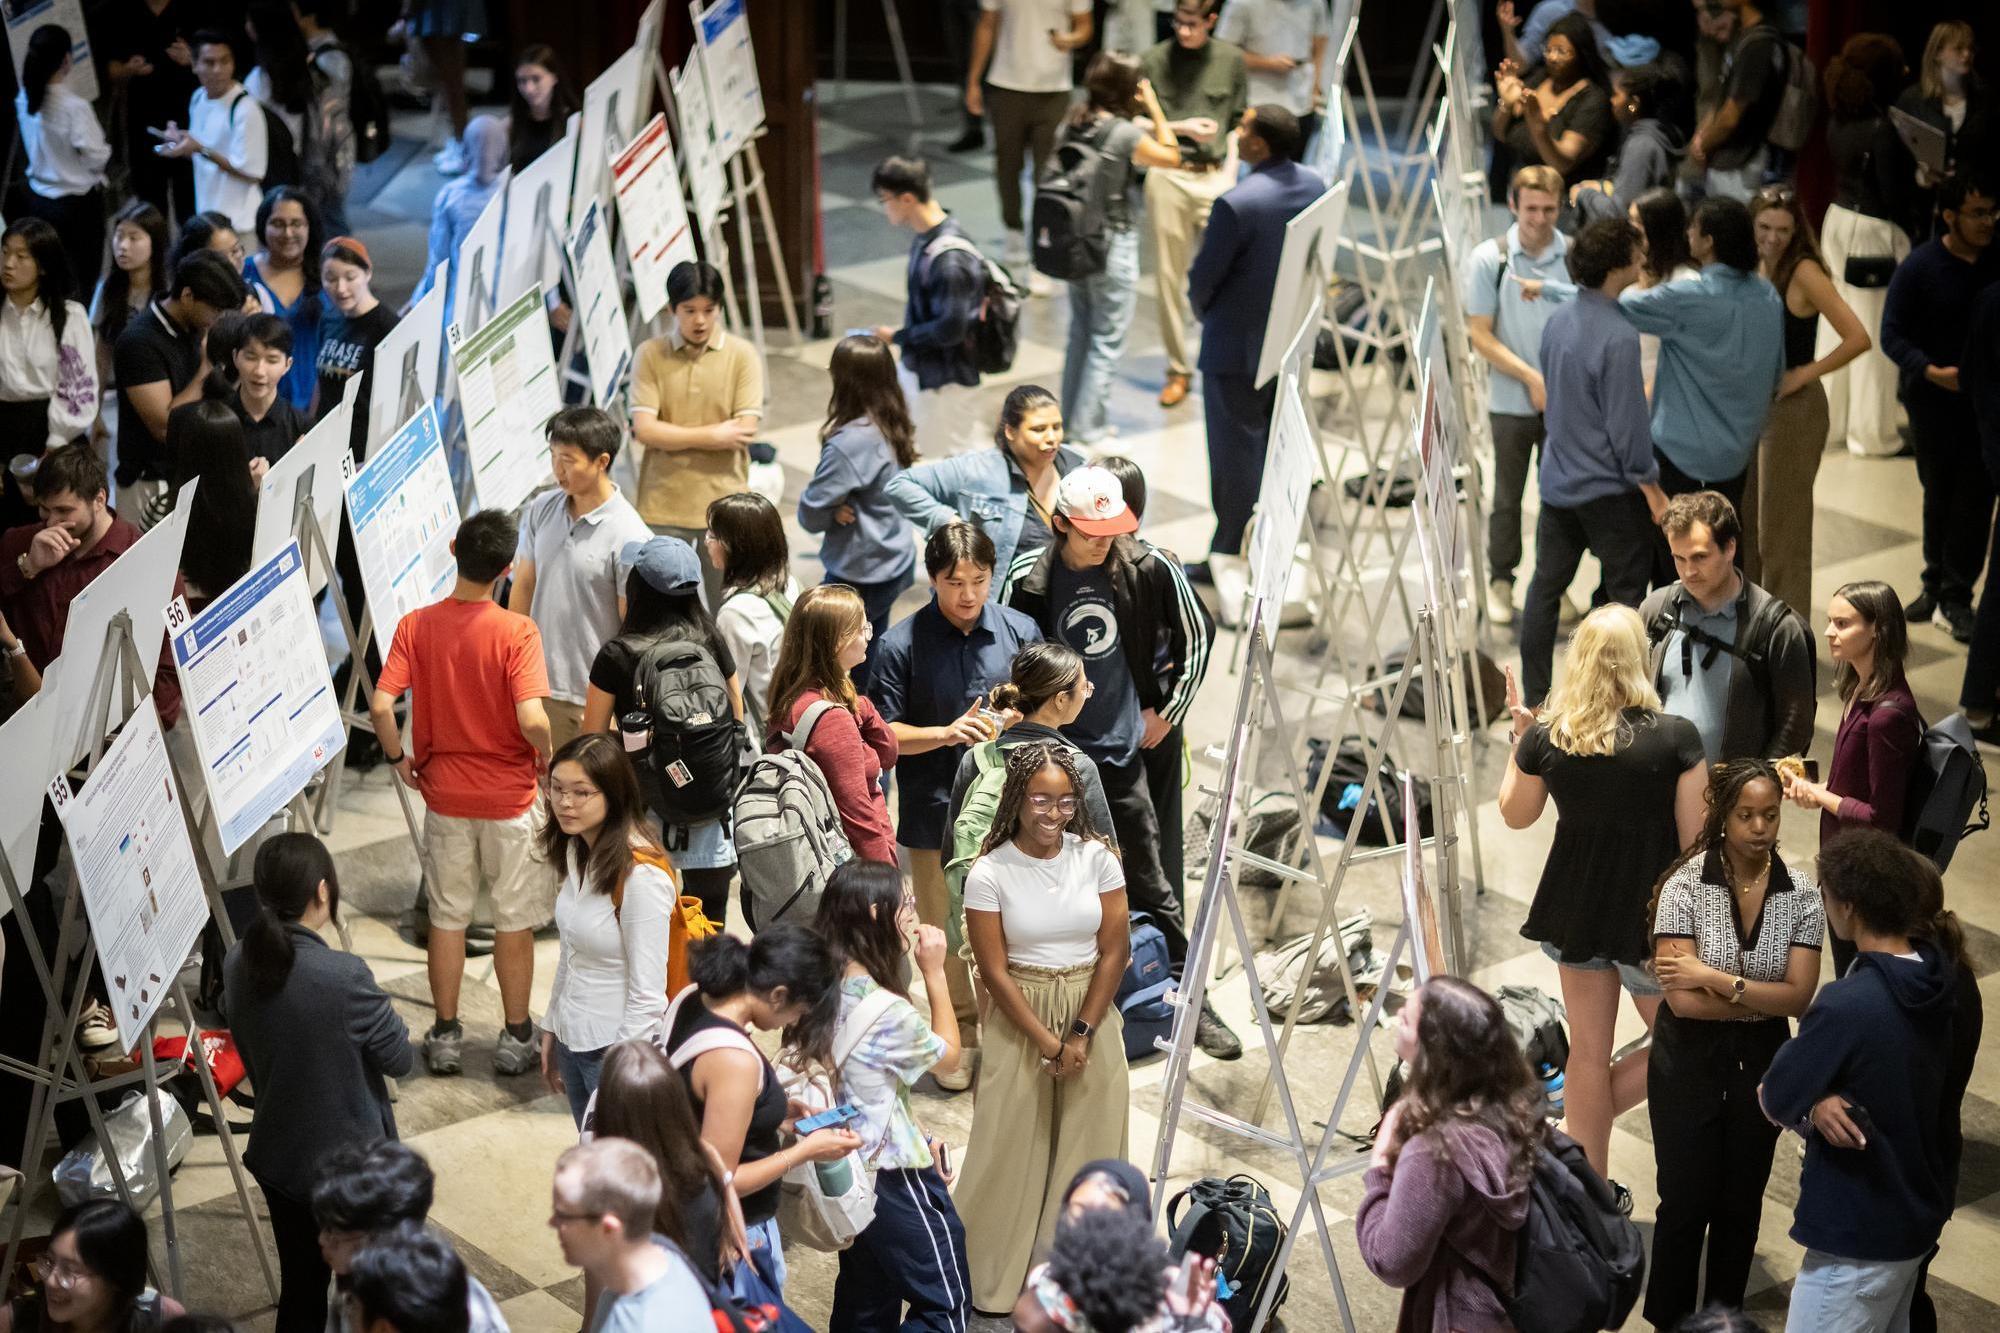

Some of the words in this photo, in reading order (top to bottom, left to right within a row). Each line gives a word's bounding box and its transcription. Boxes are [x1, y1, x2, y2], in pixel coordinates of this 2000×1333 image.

[320, 338, 365, 362] ERASE
[342, 455, 352, 480] 57
[166, 601, 184, 628] 56
[51, 774, 68, 806] 55
